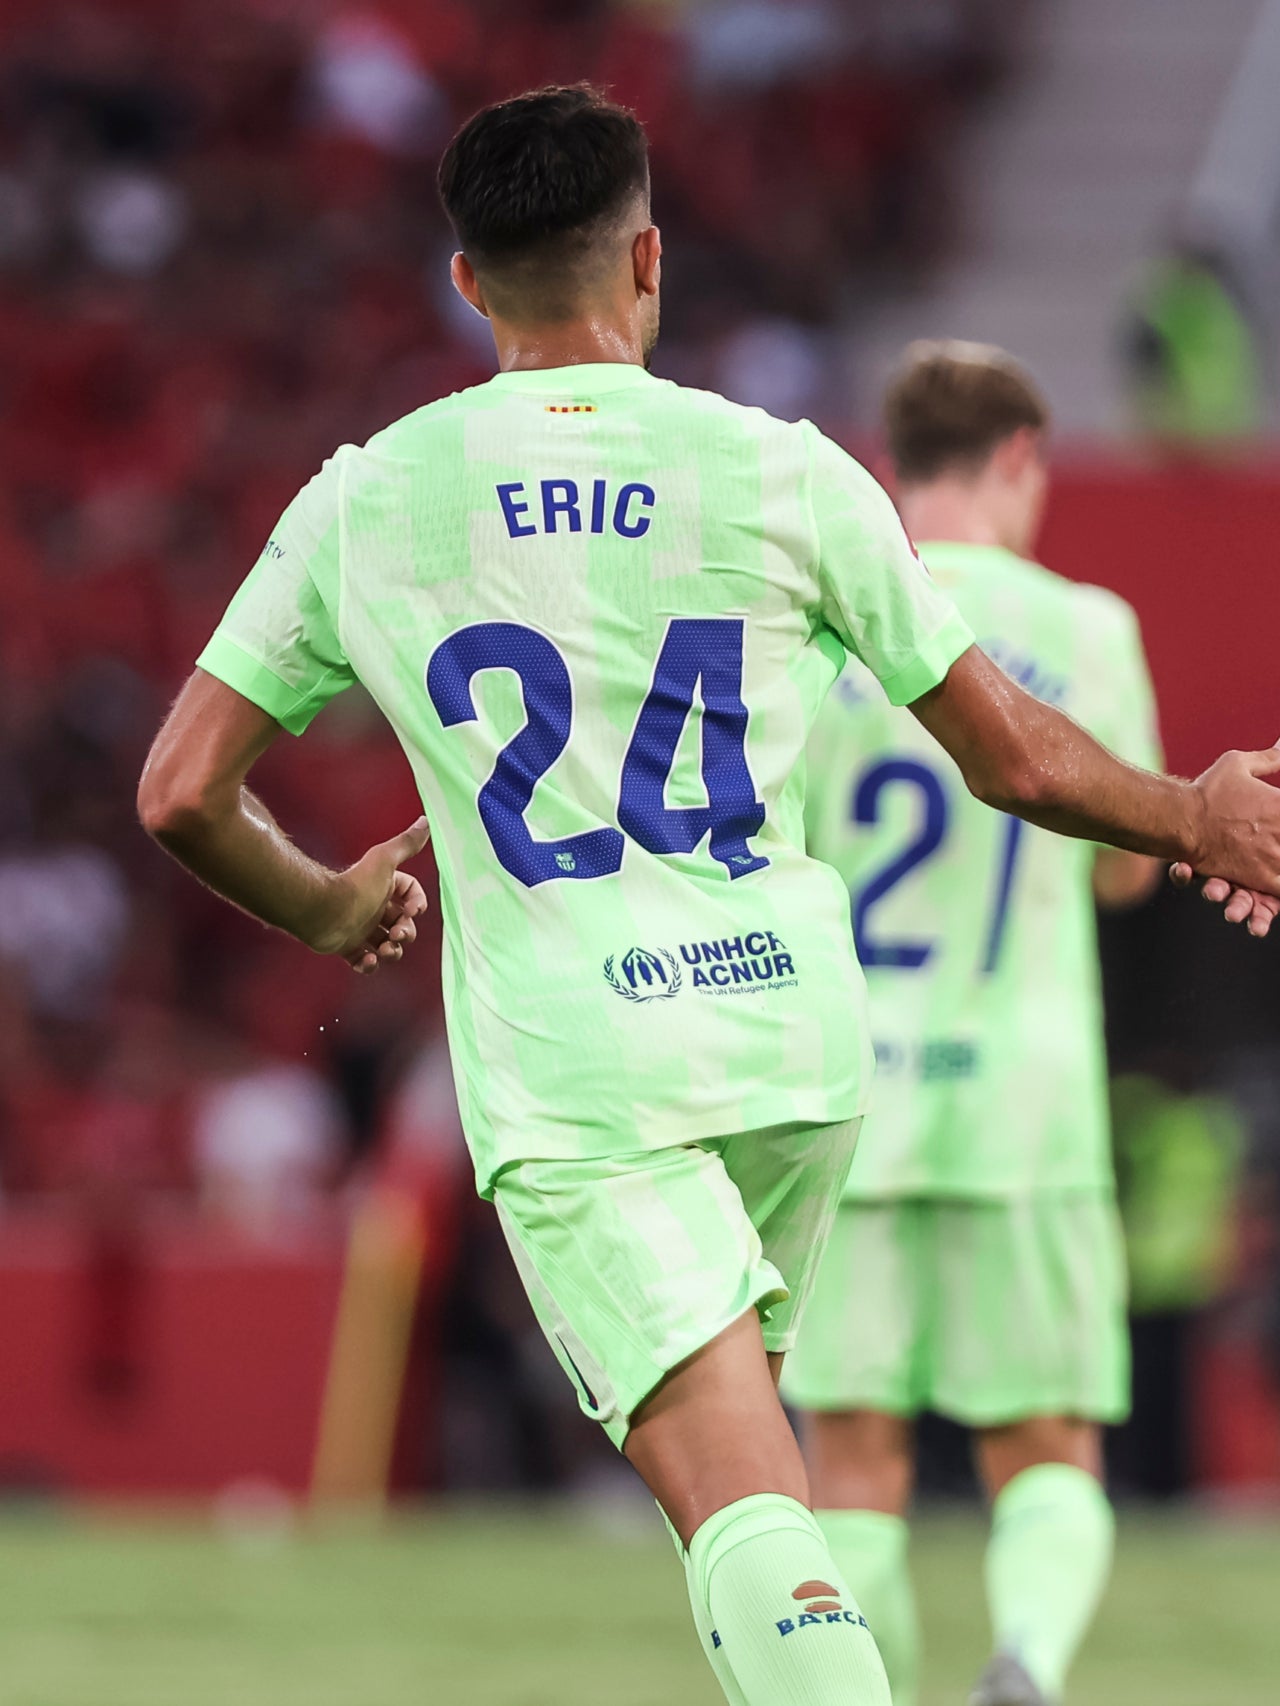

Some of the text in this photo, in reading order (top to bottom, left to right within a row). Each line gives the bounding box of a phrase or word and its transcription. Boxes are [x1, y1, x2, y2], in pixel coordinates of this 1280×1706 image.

[495, 478, 657, 539] ERIC
[425, 618, 770, 888] 24
[692, 952, 795, 987] ACNUR
[714, 987, 728, 996] UN
[729, 983, 767, 994] Refugee
[767, 979, 799, 990] Agency
